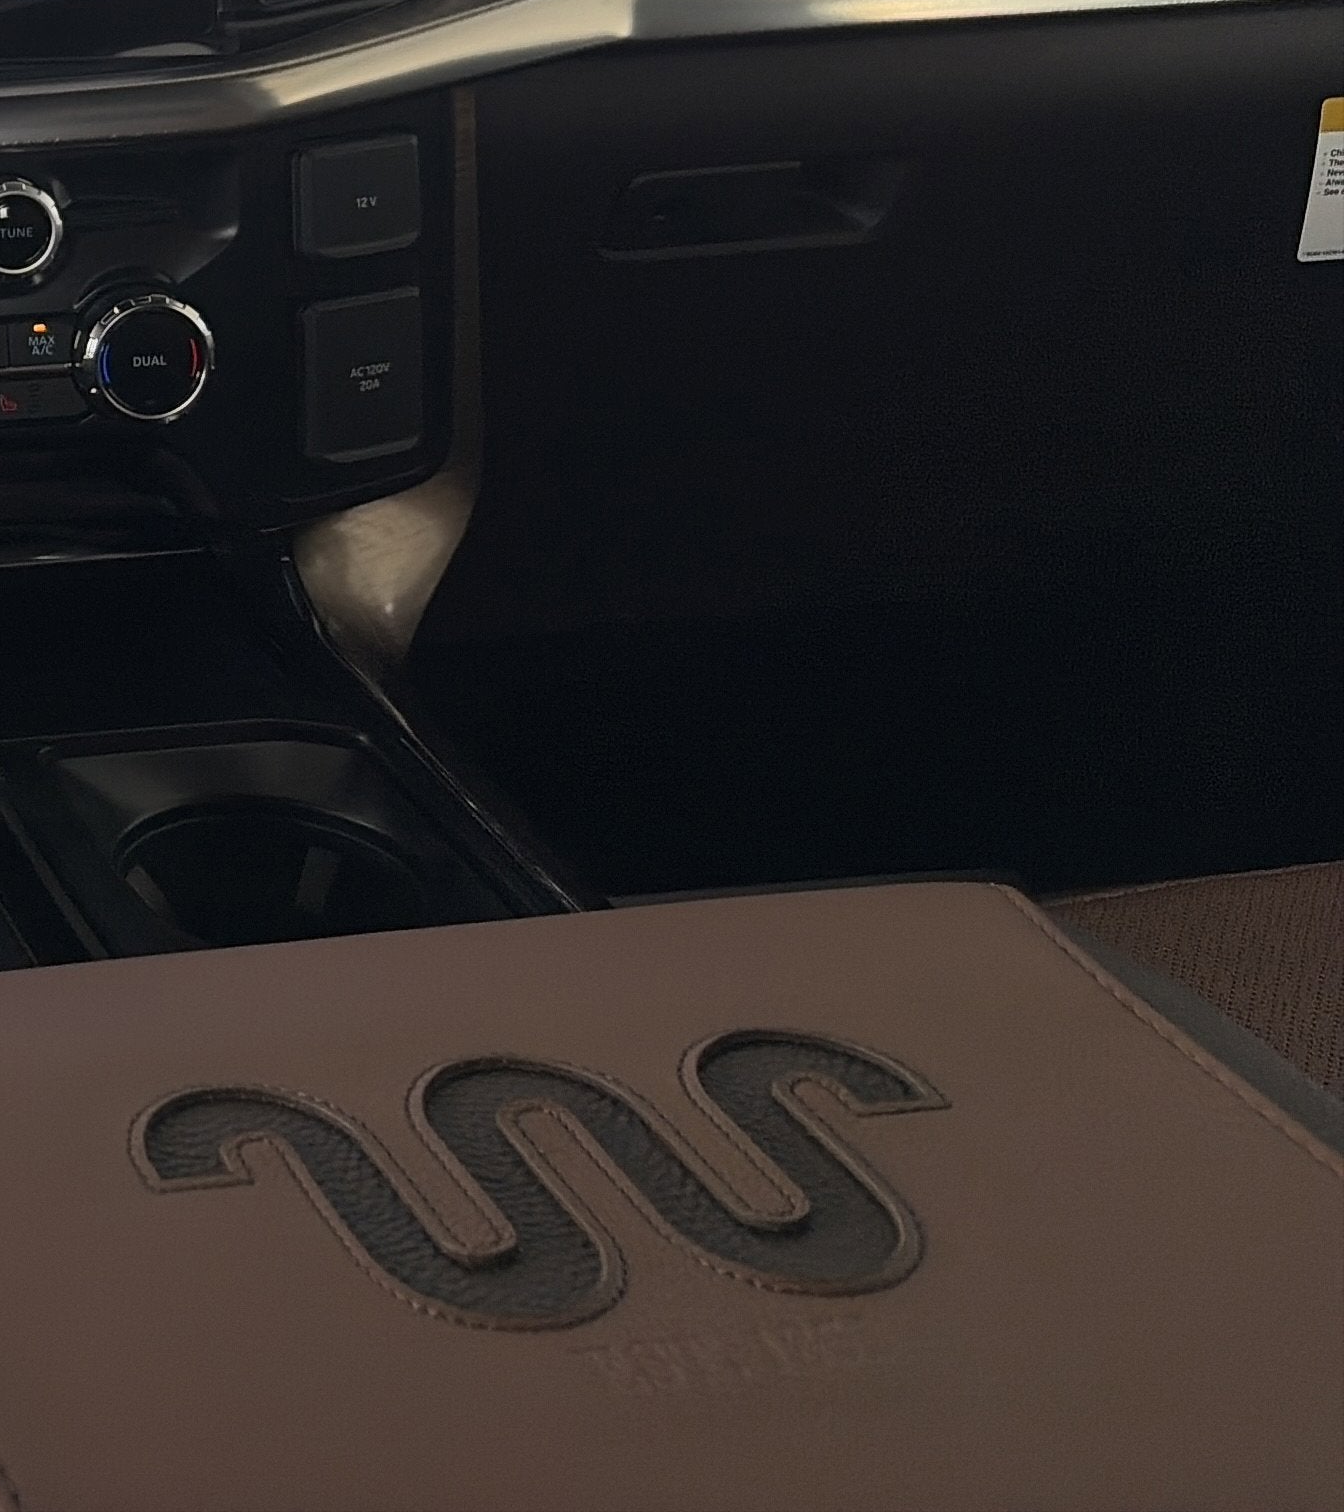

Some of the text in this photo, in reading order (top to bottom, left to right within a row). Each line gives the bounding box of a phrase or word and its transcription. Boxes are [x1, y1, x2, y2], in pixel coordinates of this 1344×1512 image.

[0, 227, 33, 239] TUNE
[28, 335, 56, 347] MAX
[30, 344, 54, 356] A/C
[132, 355, 167, 368] DUAL
